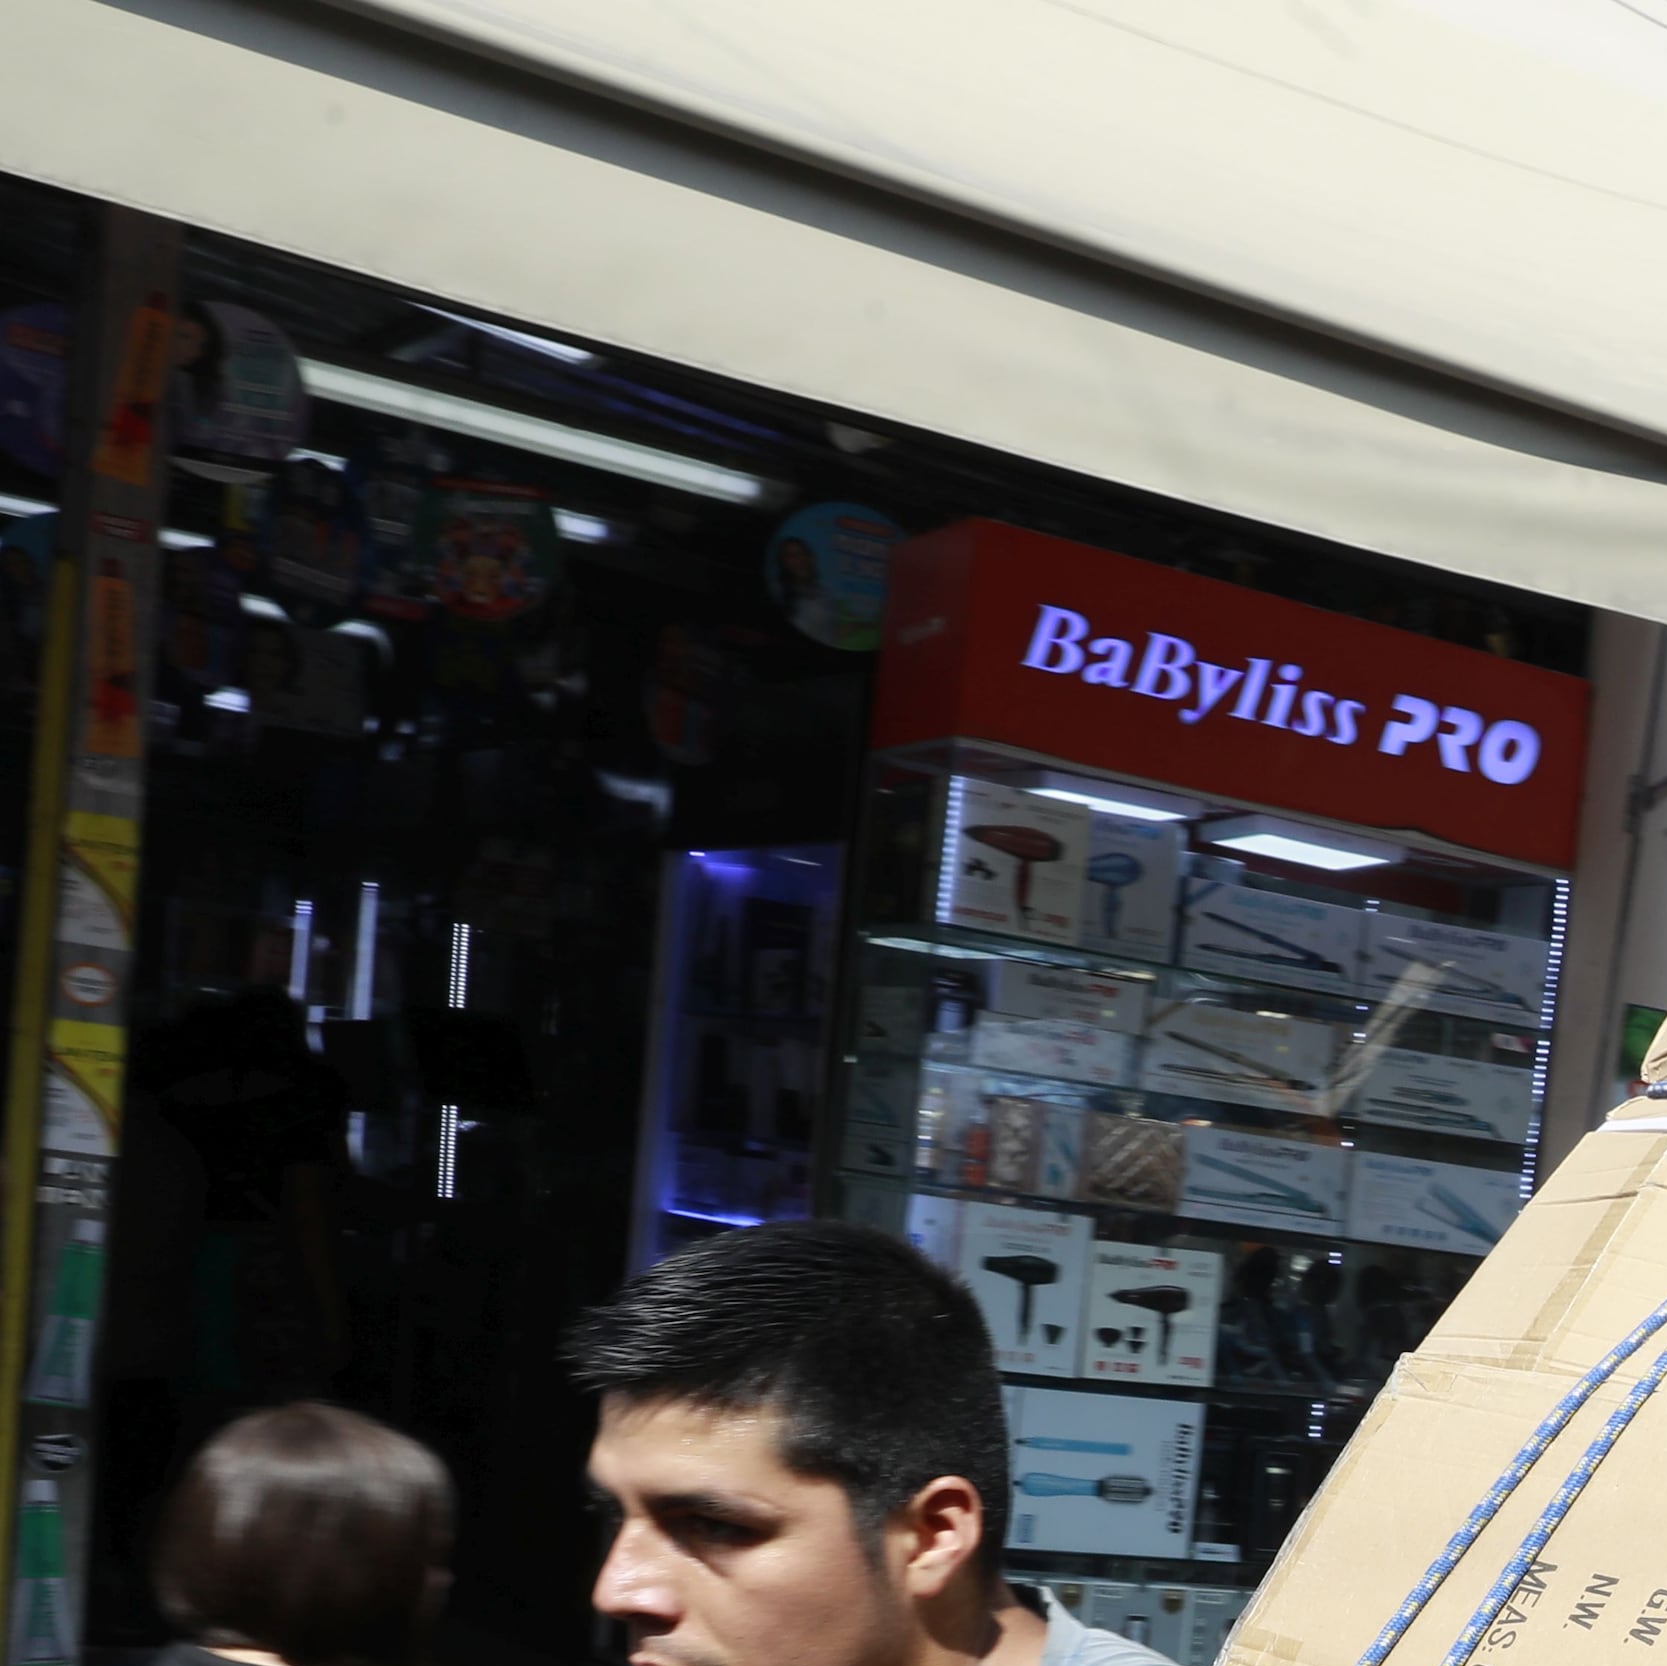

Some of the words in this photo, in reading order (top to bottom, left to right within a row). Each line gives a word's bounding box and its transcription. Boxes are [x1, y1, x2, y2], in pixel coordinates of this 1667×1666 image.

[1021, 603, 1367, 747] BaByliss
[1377, 694, 1543, 786] PRO
[1562, 1573, 1620, 1631] N.W.
